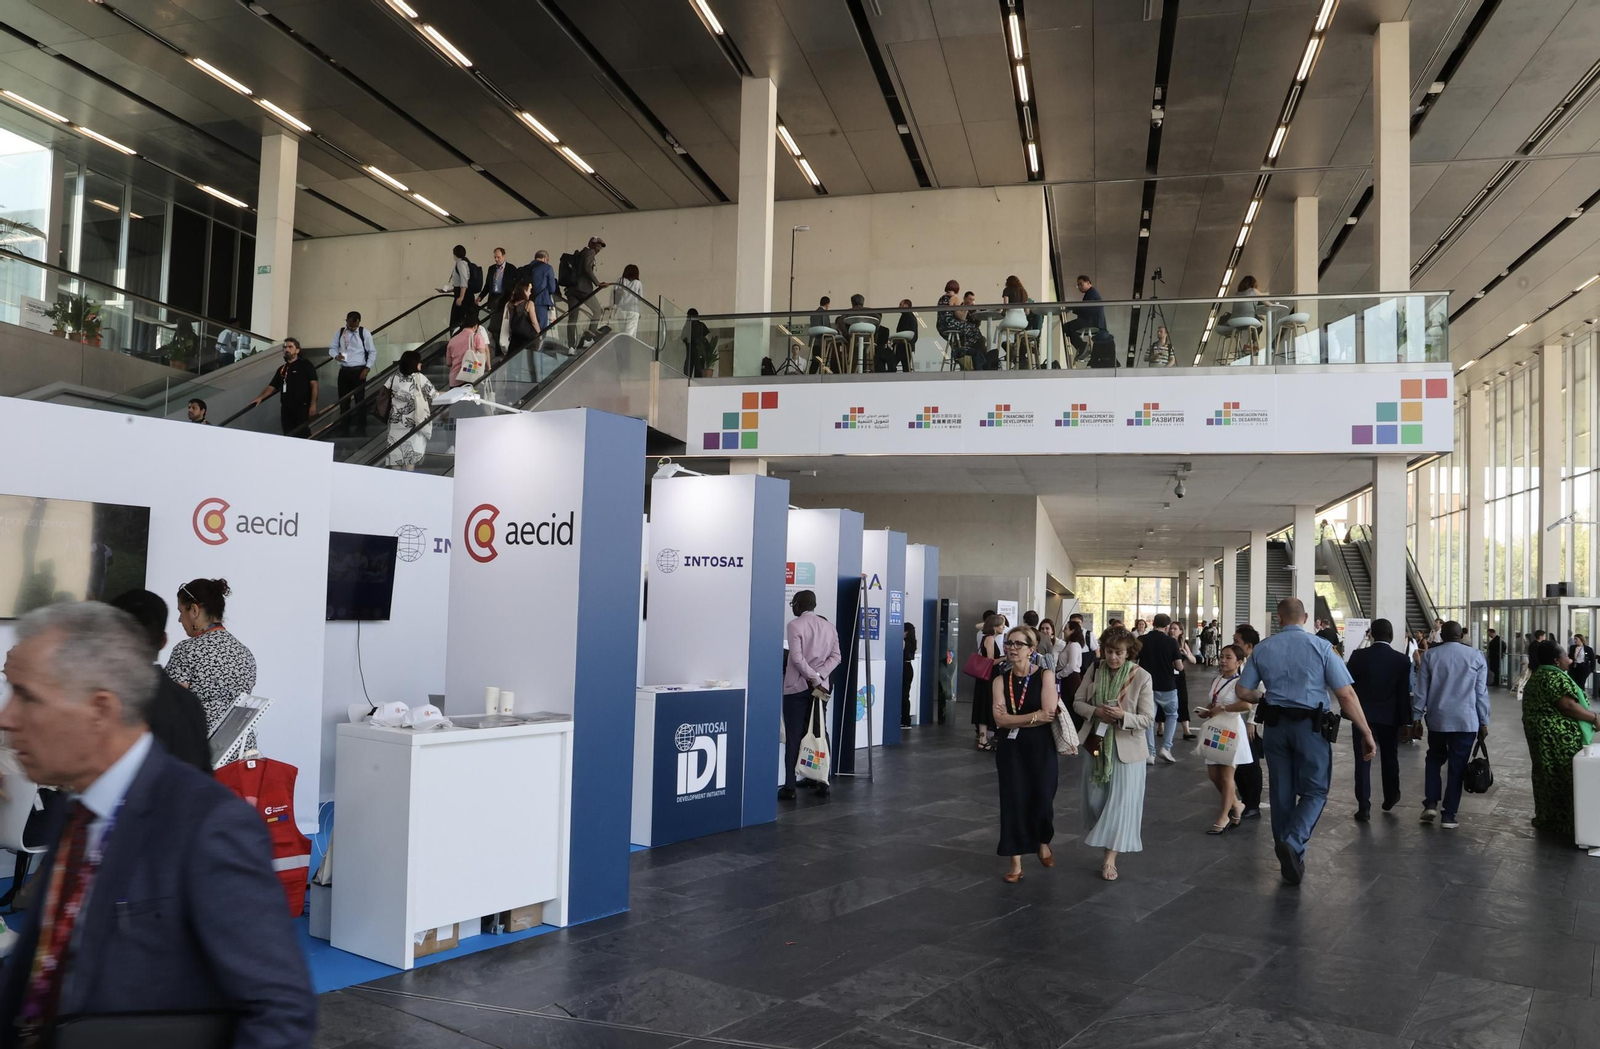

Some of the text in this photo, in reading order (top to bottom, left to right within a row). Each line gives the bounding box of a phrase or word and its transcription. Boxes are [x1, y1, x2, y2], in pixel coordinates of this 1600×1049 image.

[236, 512, 298, 537] aecid
[505, 511, 574, 546] aecid
[684, 556, 744, 568] INTOSAI
[696, 722, 728, 735] INTOSAI
[1208, 726, 1222, 734] FFD4
[676, 790, 726, 803] DEVELOPMENT INITIATIVE
